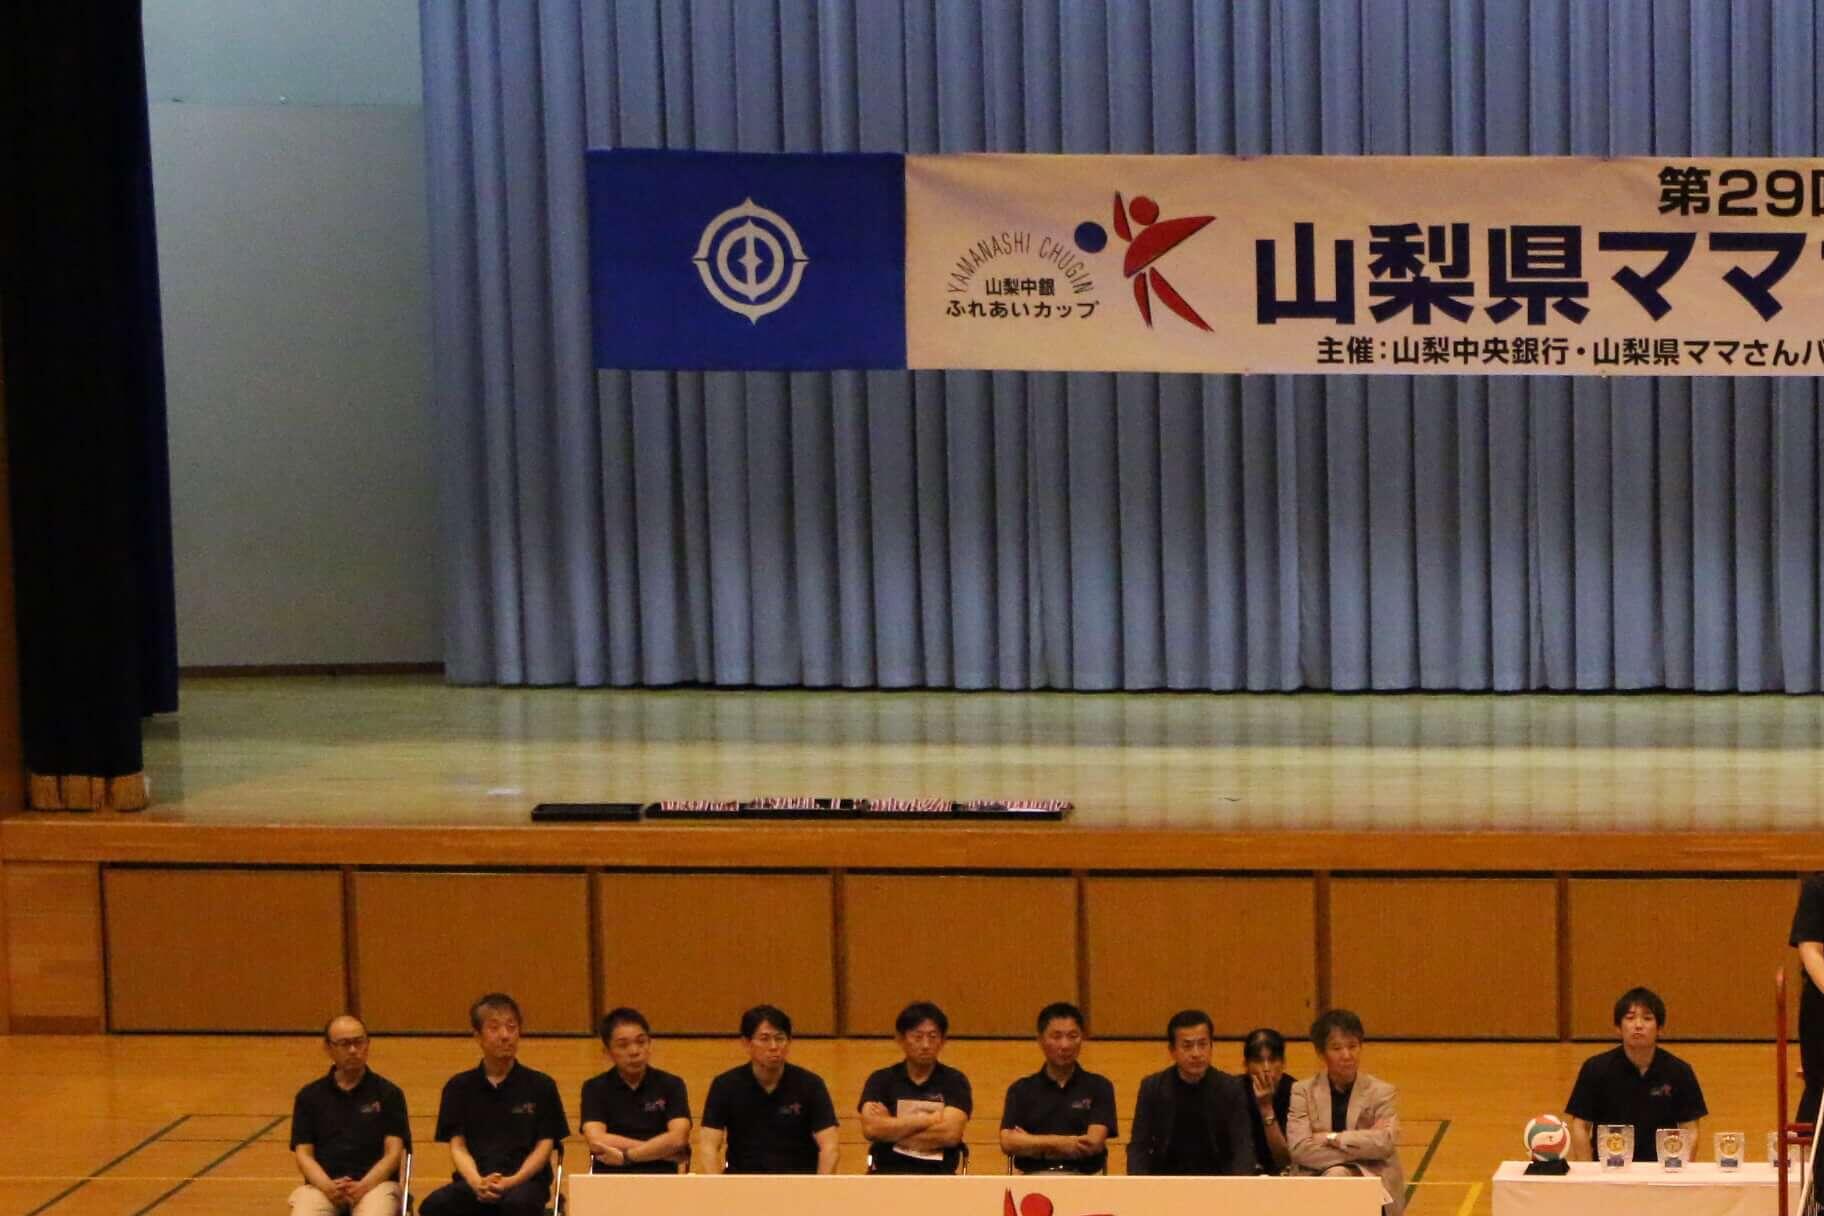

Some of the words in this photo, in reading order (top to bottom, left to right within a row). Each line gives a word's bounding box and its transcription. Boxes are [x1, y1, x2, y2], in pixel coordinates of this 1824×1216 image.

[946, 231, 1031, 296] YAMANASHI
[1038, 235, 1094, 296] CHUGIN
[985, 277, 1056, 297] 山梨中銀
[945, 300, 1101, 320] ふれあいカップ
